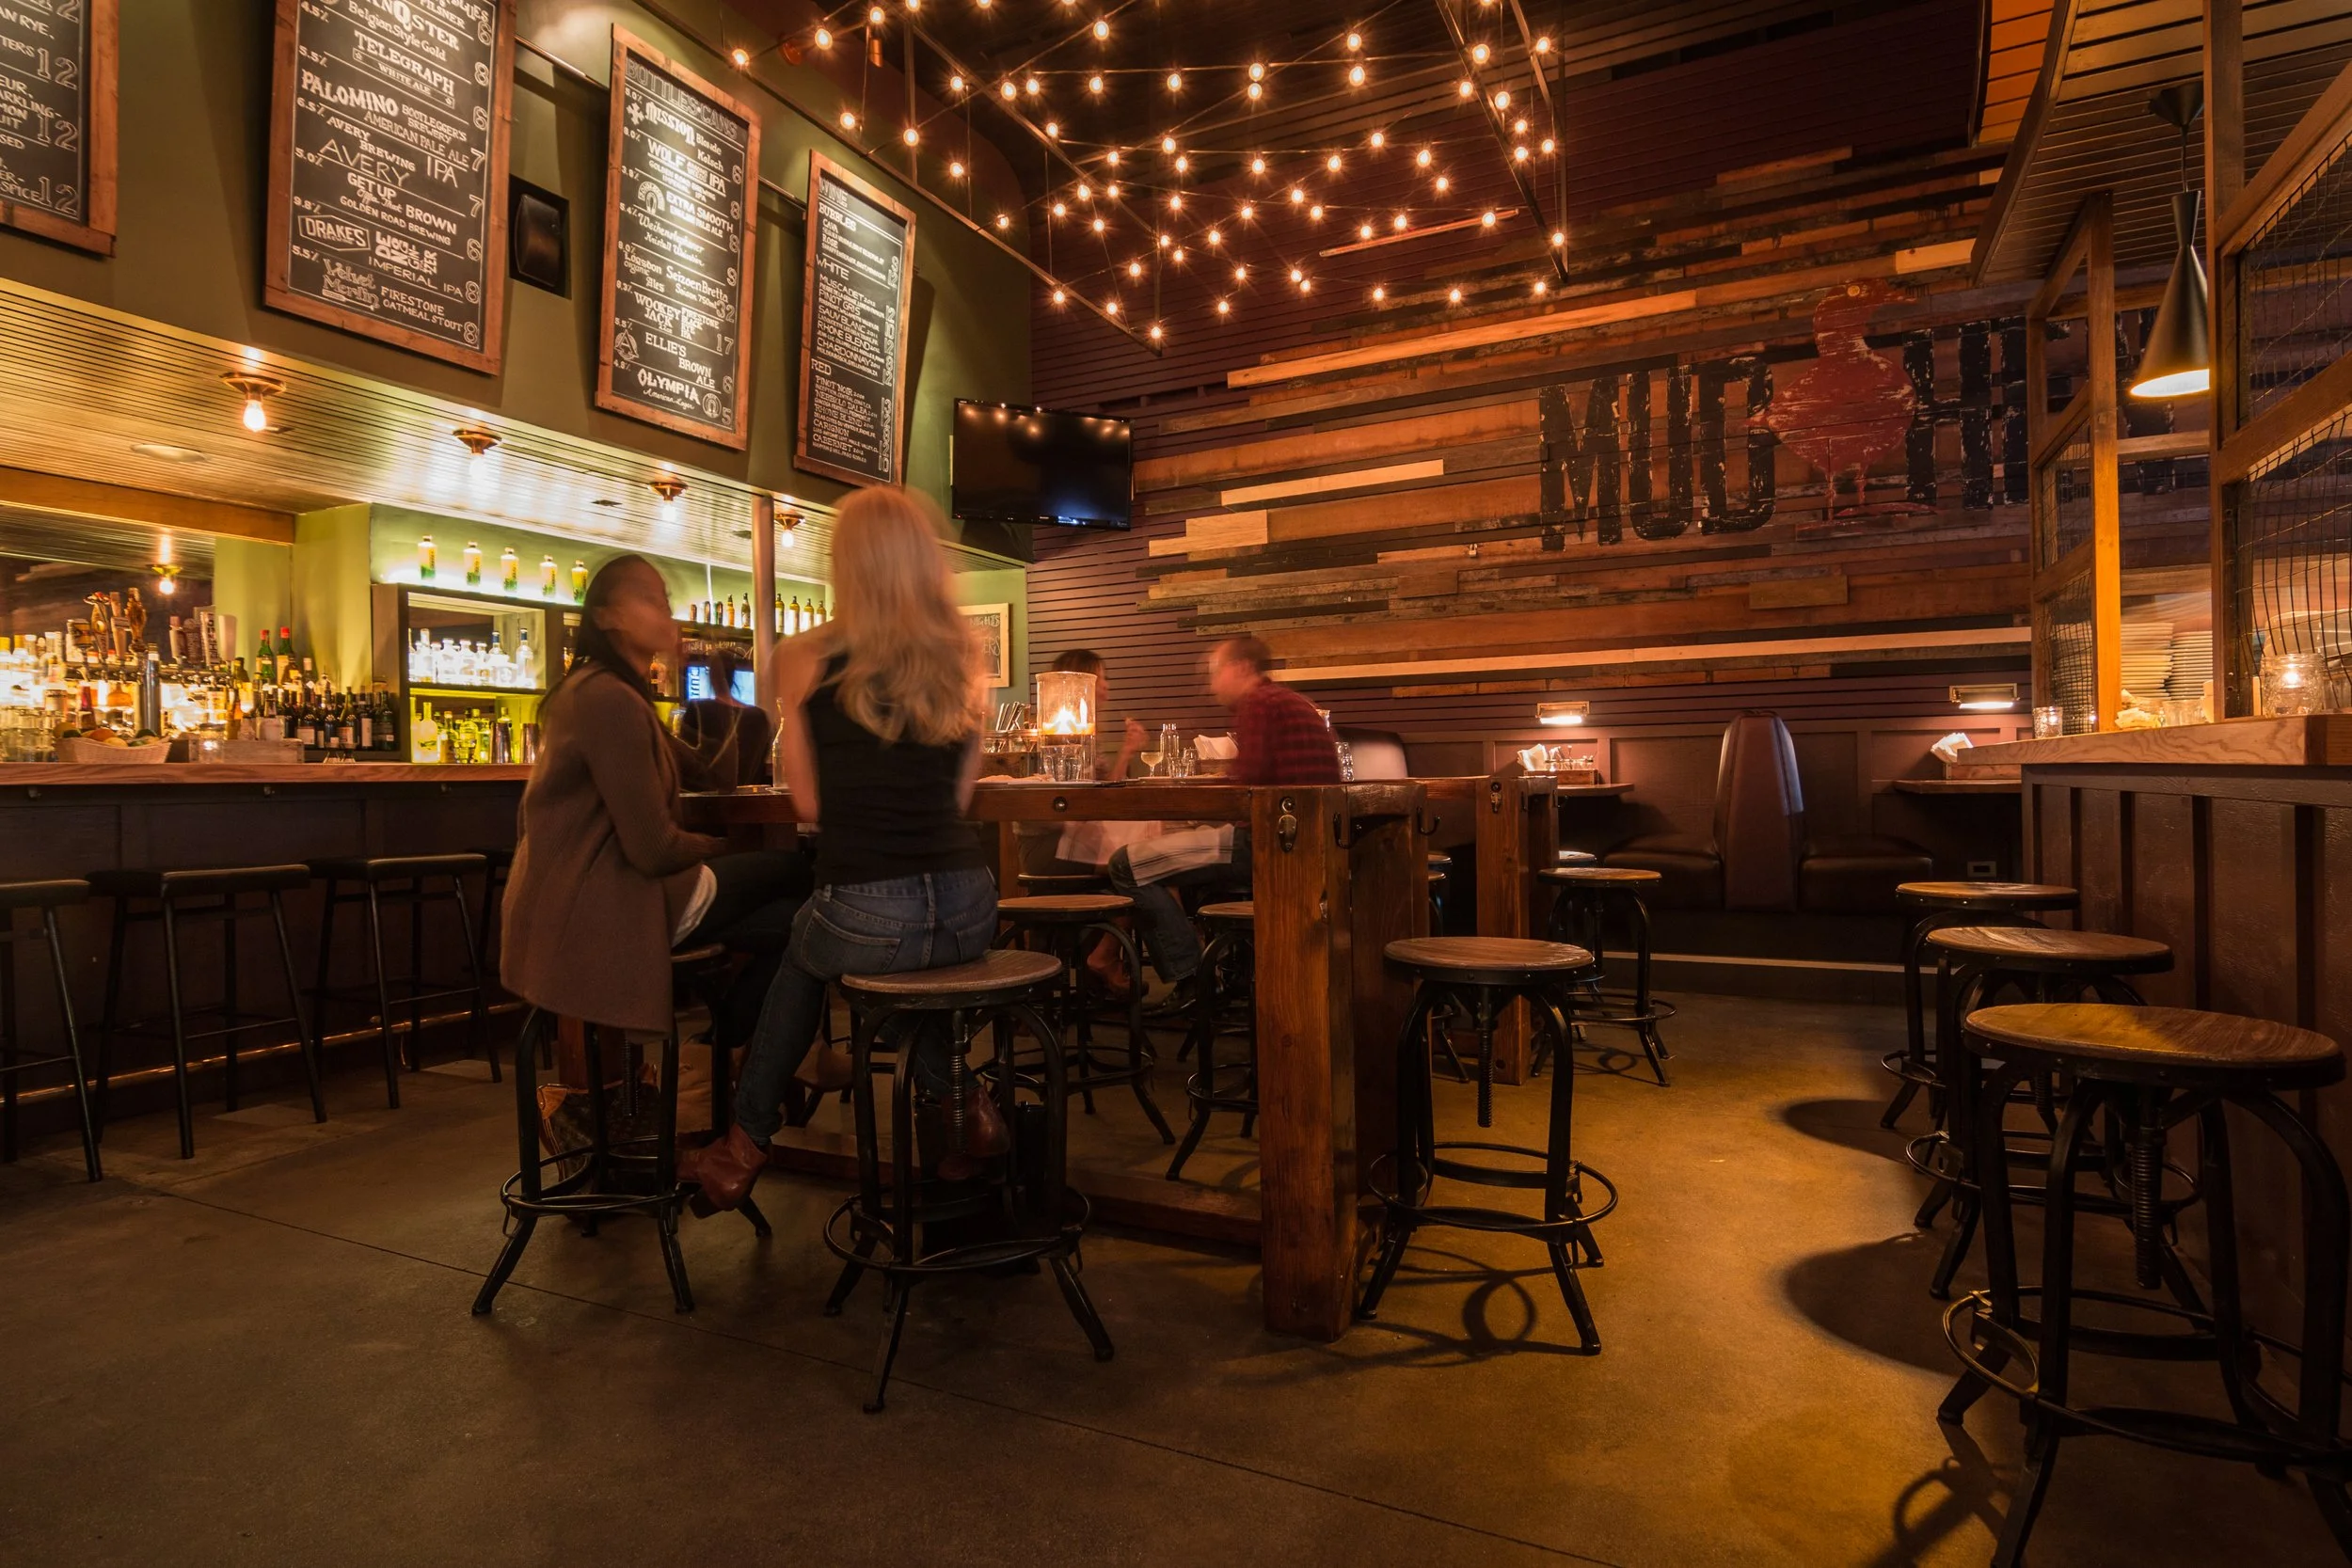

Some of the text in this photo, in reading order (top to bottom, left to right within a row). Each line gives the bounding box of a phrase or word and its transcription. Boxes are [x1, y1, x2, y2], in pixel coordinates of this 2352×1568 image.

[478, 20, 492, 46] 6
[37, 47, 77, 90] 12
[354, 29, 455, 97] TELEGRAPH
[474, 61, 489, 87] 8
[378, 62, 432, 96] WHITE ALE
[301, 69, 400, 118] PALOMINO
[326, 115, 372, 143] AVERY
[472, 104, 487, 132] 6
[363, 110, 471, 170] AMERICAN PALE ALE
[318, 137, 459, 189] AVERY IPA
[358, 138, 417, 173] BREWING
[469, 146, 485, 173] 7
[647, 137, 687, 169] WOLF
[708, 171, 726, 195] IPA
[346, 172, 398, 204] GET UP
[732, 165, 742, 185] 6
[38, 175, 77, 215] 12
[469, 193, 485, 219] 7
[339, 195, 379, 219] GOLDEN
[380, 210, 406, 230] ROAD
[407, 221, 453, 248] BREWING
[405, 203, 458, 237] BROWN
[696, 206, 734, 233] SMOOTH
[730, 200, 741, 221] 8
[466, 237, 482, 263] 6
[729, 234, 740, 253] 8
[368, 256, 438, 290] IMPERIAL
[443, 282, 464, 298] IPA
[816, 254, 850, 281] WHITE
[380, 285, 445, 317] FIRESTONE
[465, 280, 481, 305] 8
[819, 273, 866, 302] MUSCADET
[382, 299, 464, 332] OATMEAL STOUT
[633, 291, 682, 322] WOOKEY
[644, 306, 674, 329] JACK
[715, 298, 736, 324] 32
[842, 300, 862, 317] GRIS
[463, 321, 479, 344] 8
[840, 314, 867, 335] BLANC
[644, 331, 687, 357] ELLIE'S
[715, 333, 735, 356] 17
[817, 337, 872, 368] CHARDONNAY
[677, 356, 712, 378] BROWN
[811, 357, 832, 376] RED
[637, 368, 702, 405] OLYMPIA
[695, 374, 717, 390] ALE
[722, 374, 734, 395] 6
[721, 405, 732, 426] 5
[813, 433, 853, 452] CABERNET
[1539, 355, 1776, 553] MUD
